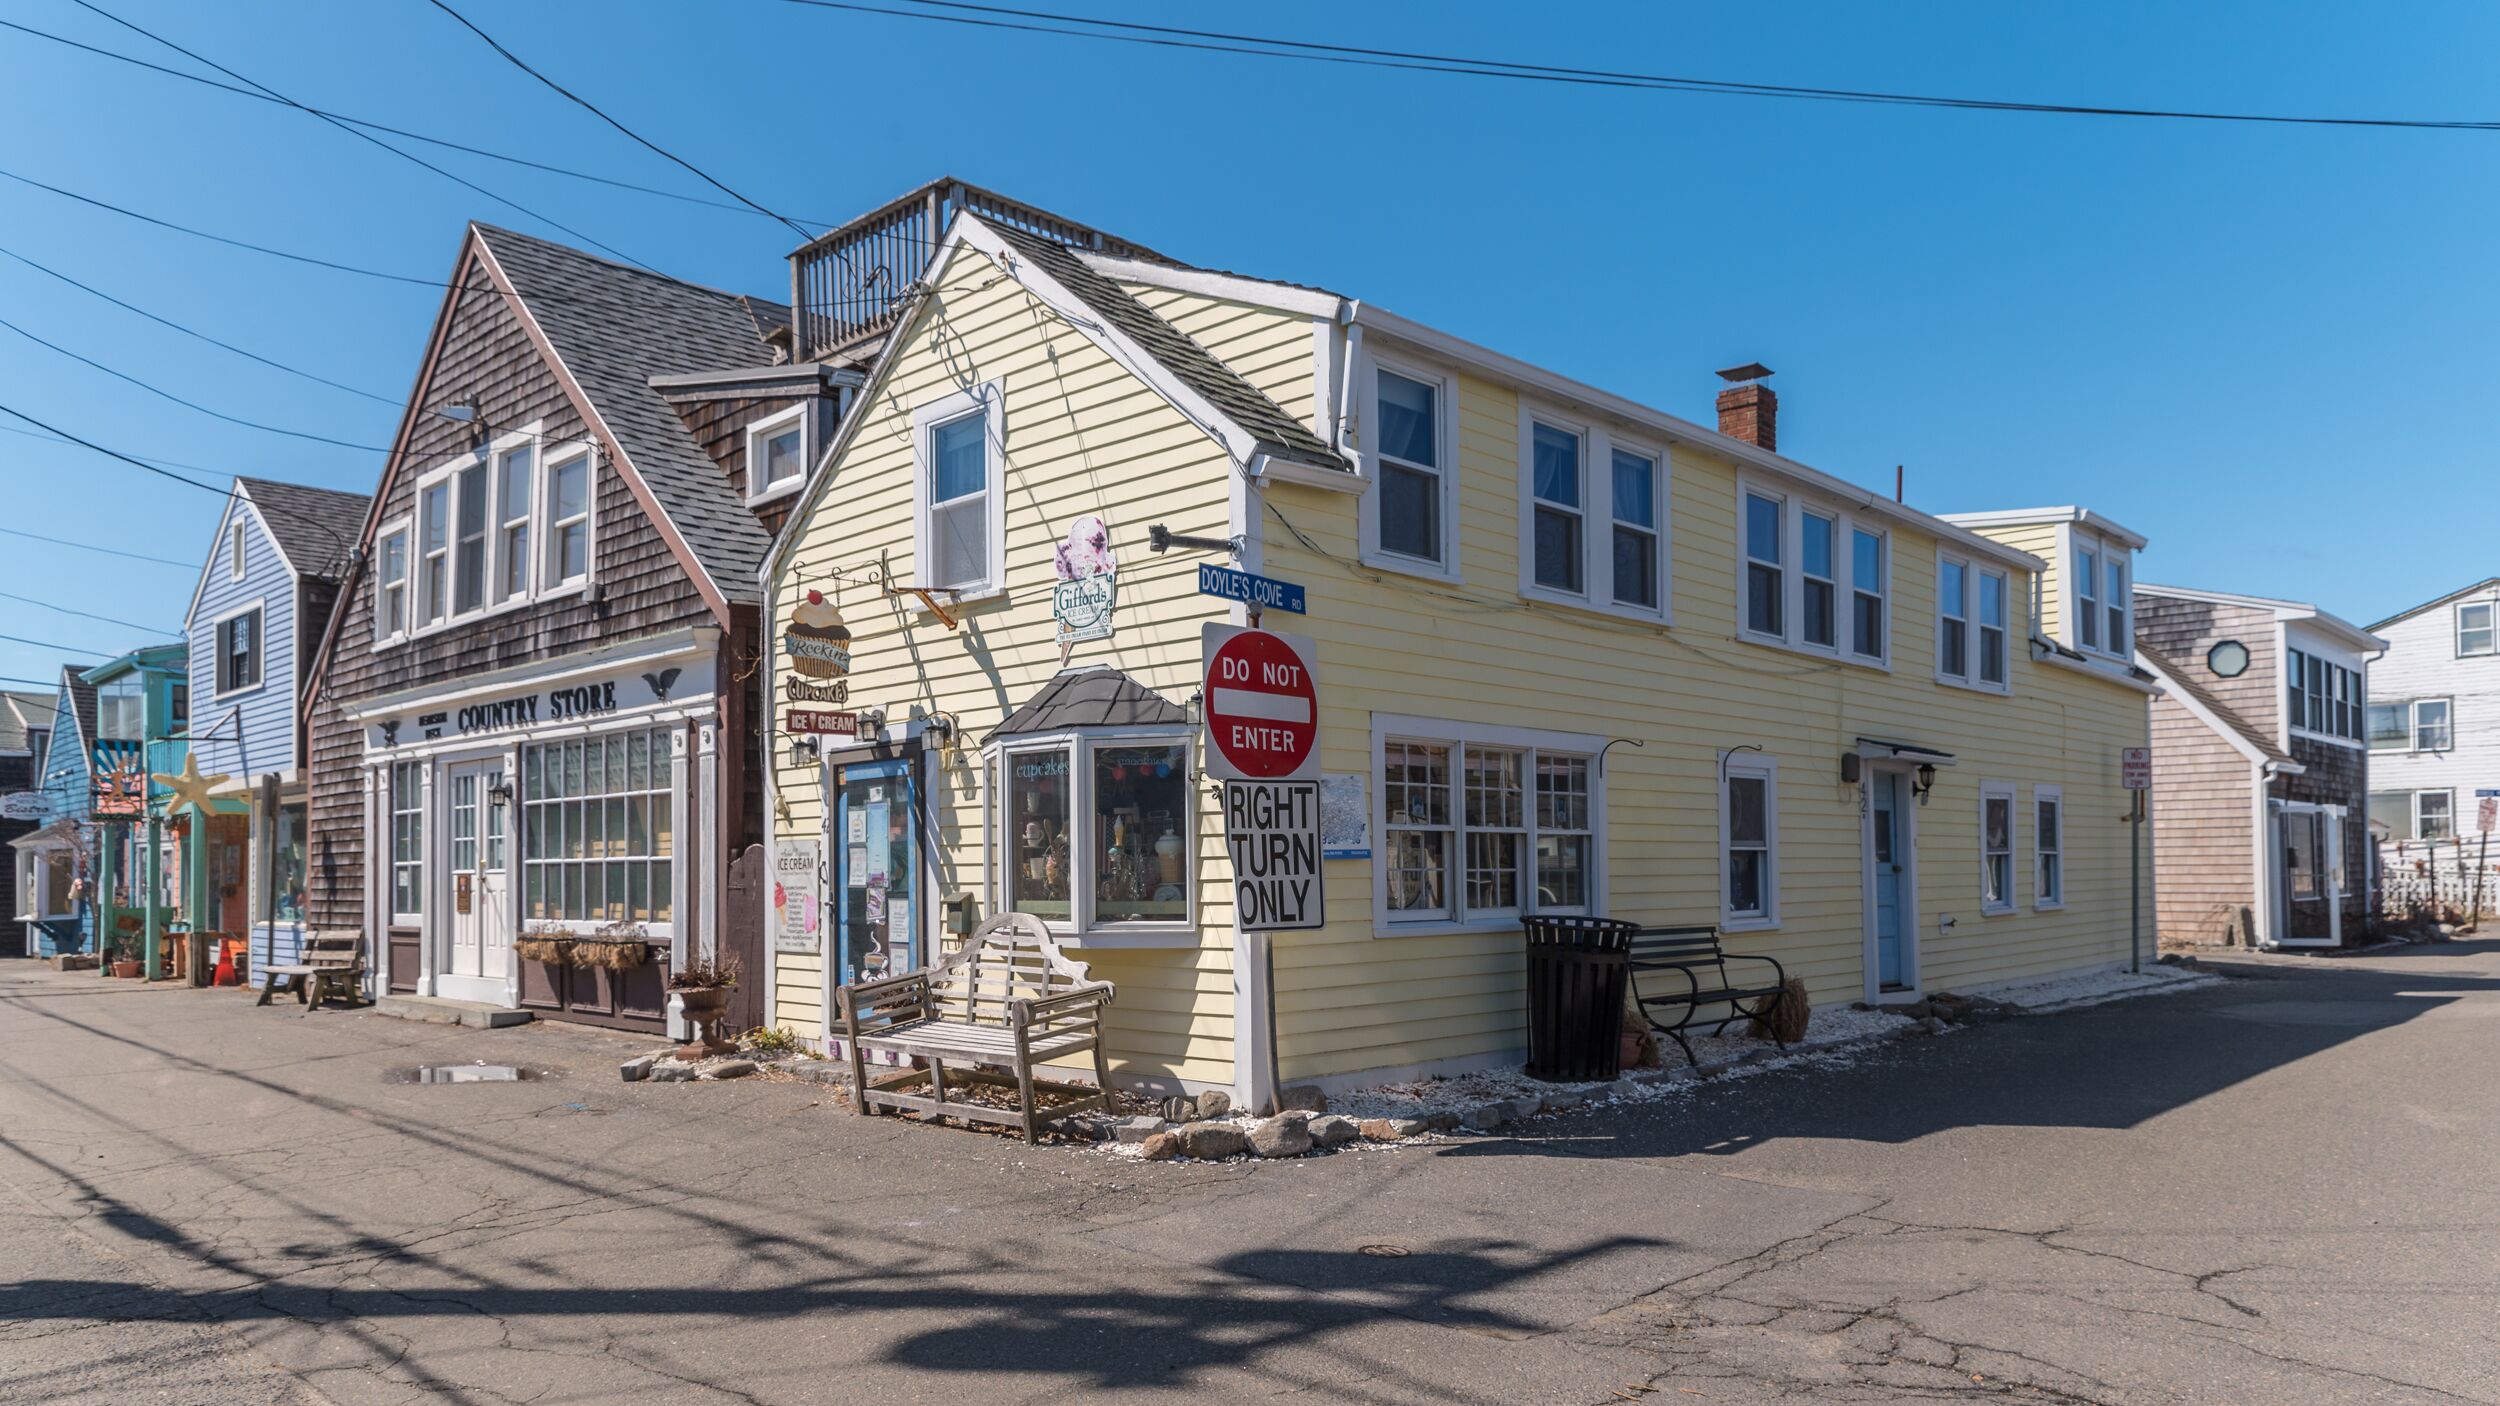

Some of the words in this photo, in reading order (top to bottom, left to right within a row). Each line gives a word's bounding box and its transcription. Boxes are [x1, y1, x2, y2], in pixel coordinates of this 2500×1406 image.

[1059, 582, 1107, 611] Gifford's
[1202, 568, 1249, 600] DOYLE'S
[1254, 579, 1283, 607] COVE
[1291, 598, 1302, 611] RD
[1222, 656, 1250, 682] DO
[1262, 661, 1300, 688] NOT
[786, 678, 848, 704] CUPCAKES
[458, 694, 539, 733] COUNTRY
[550, 681, 617, 719] STORE
[791, 714, 807, 729] ICE
[818, 715, 854, 731] CREAM
[1232, 725, 1295, 753] ENTER
[1016, 756, 1070, 782] cupcakes
[1230, 785, 1313, 830] RIGHT
[777, 857, 788, 871] ICE
[789, 857, 813, 871] CREAM
[1231, 833, 1316, 878] TURN
[1238, 879, 1311, 926] ONLY
